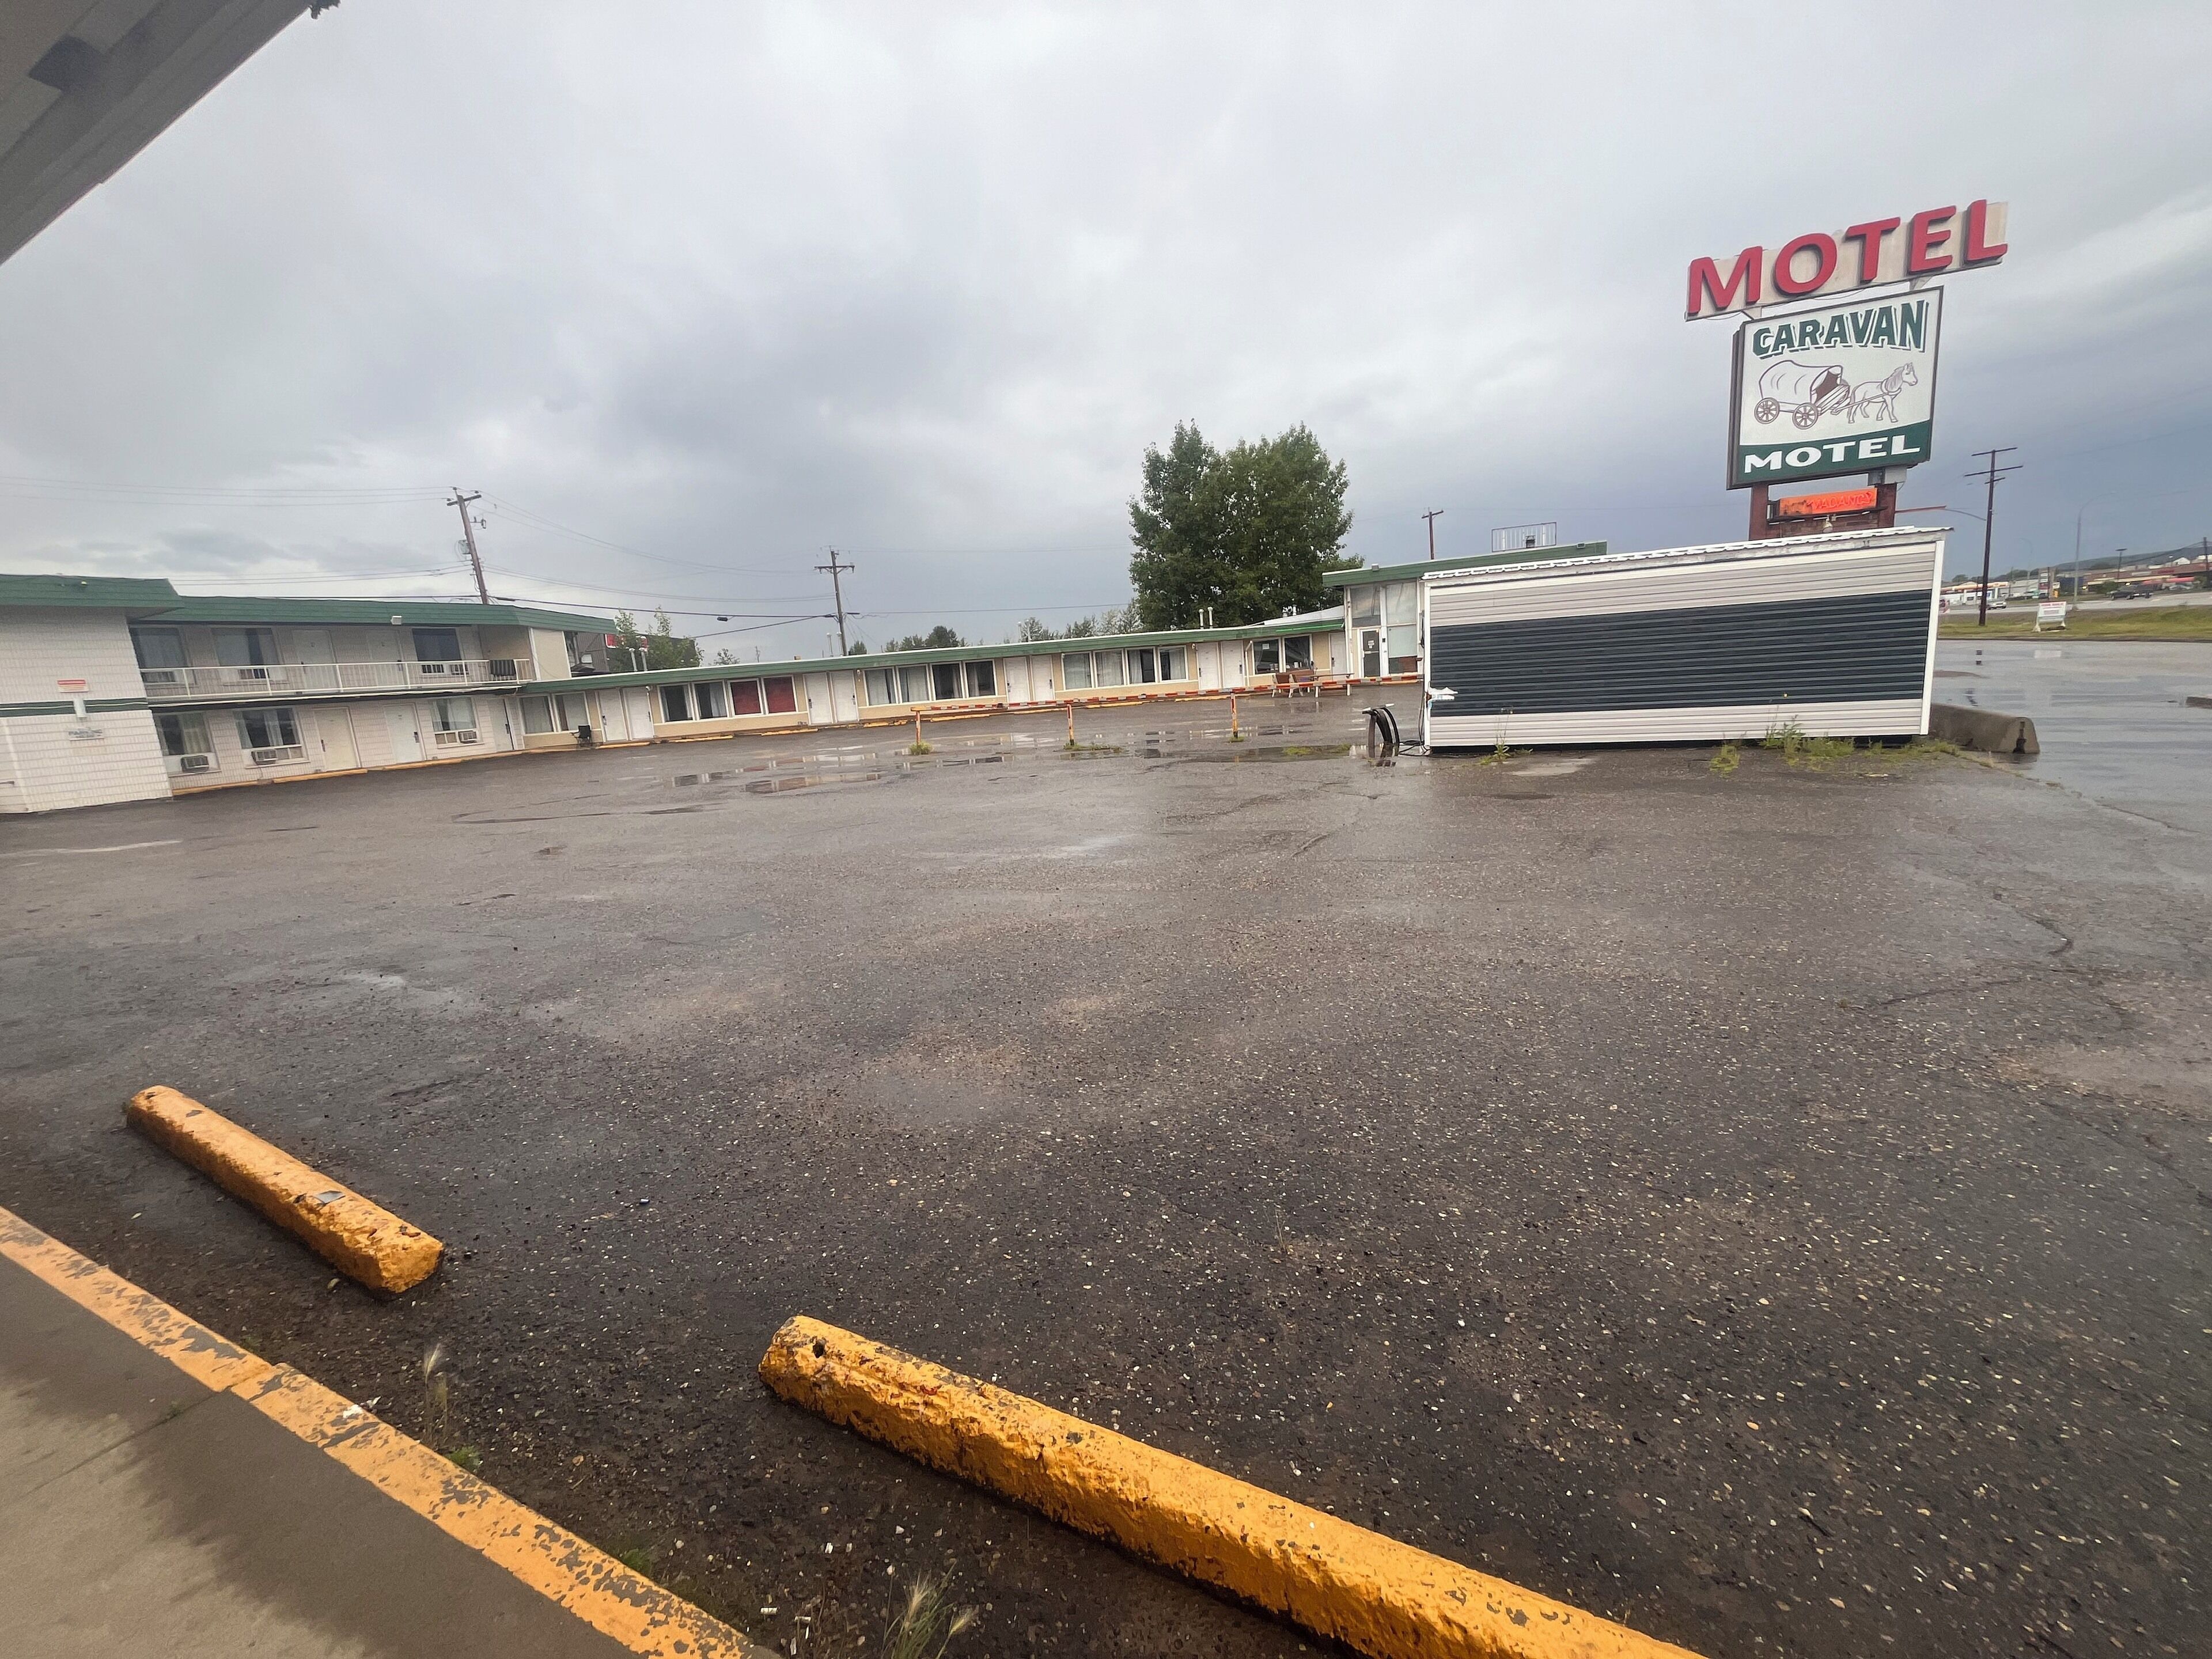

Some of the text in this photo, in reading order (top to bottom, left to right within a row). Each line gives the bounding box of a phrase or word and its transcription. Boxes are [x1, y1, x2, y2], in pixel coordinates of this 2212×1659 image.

[1688, 199, 2008, 316] MOTEL
[1752, 300, 1929, 359] CARAVAN
[1744, 435, 1921, 474] MOTEL
[1808, 491, 1872, 509] VACANCY
